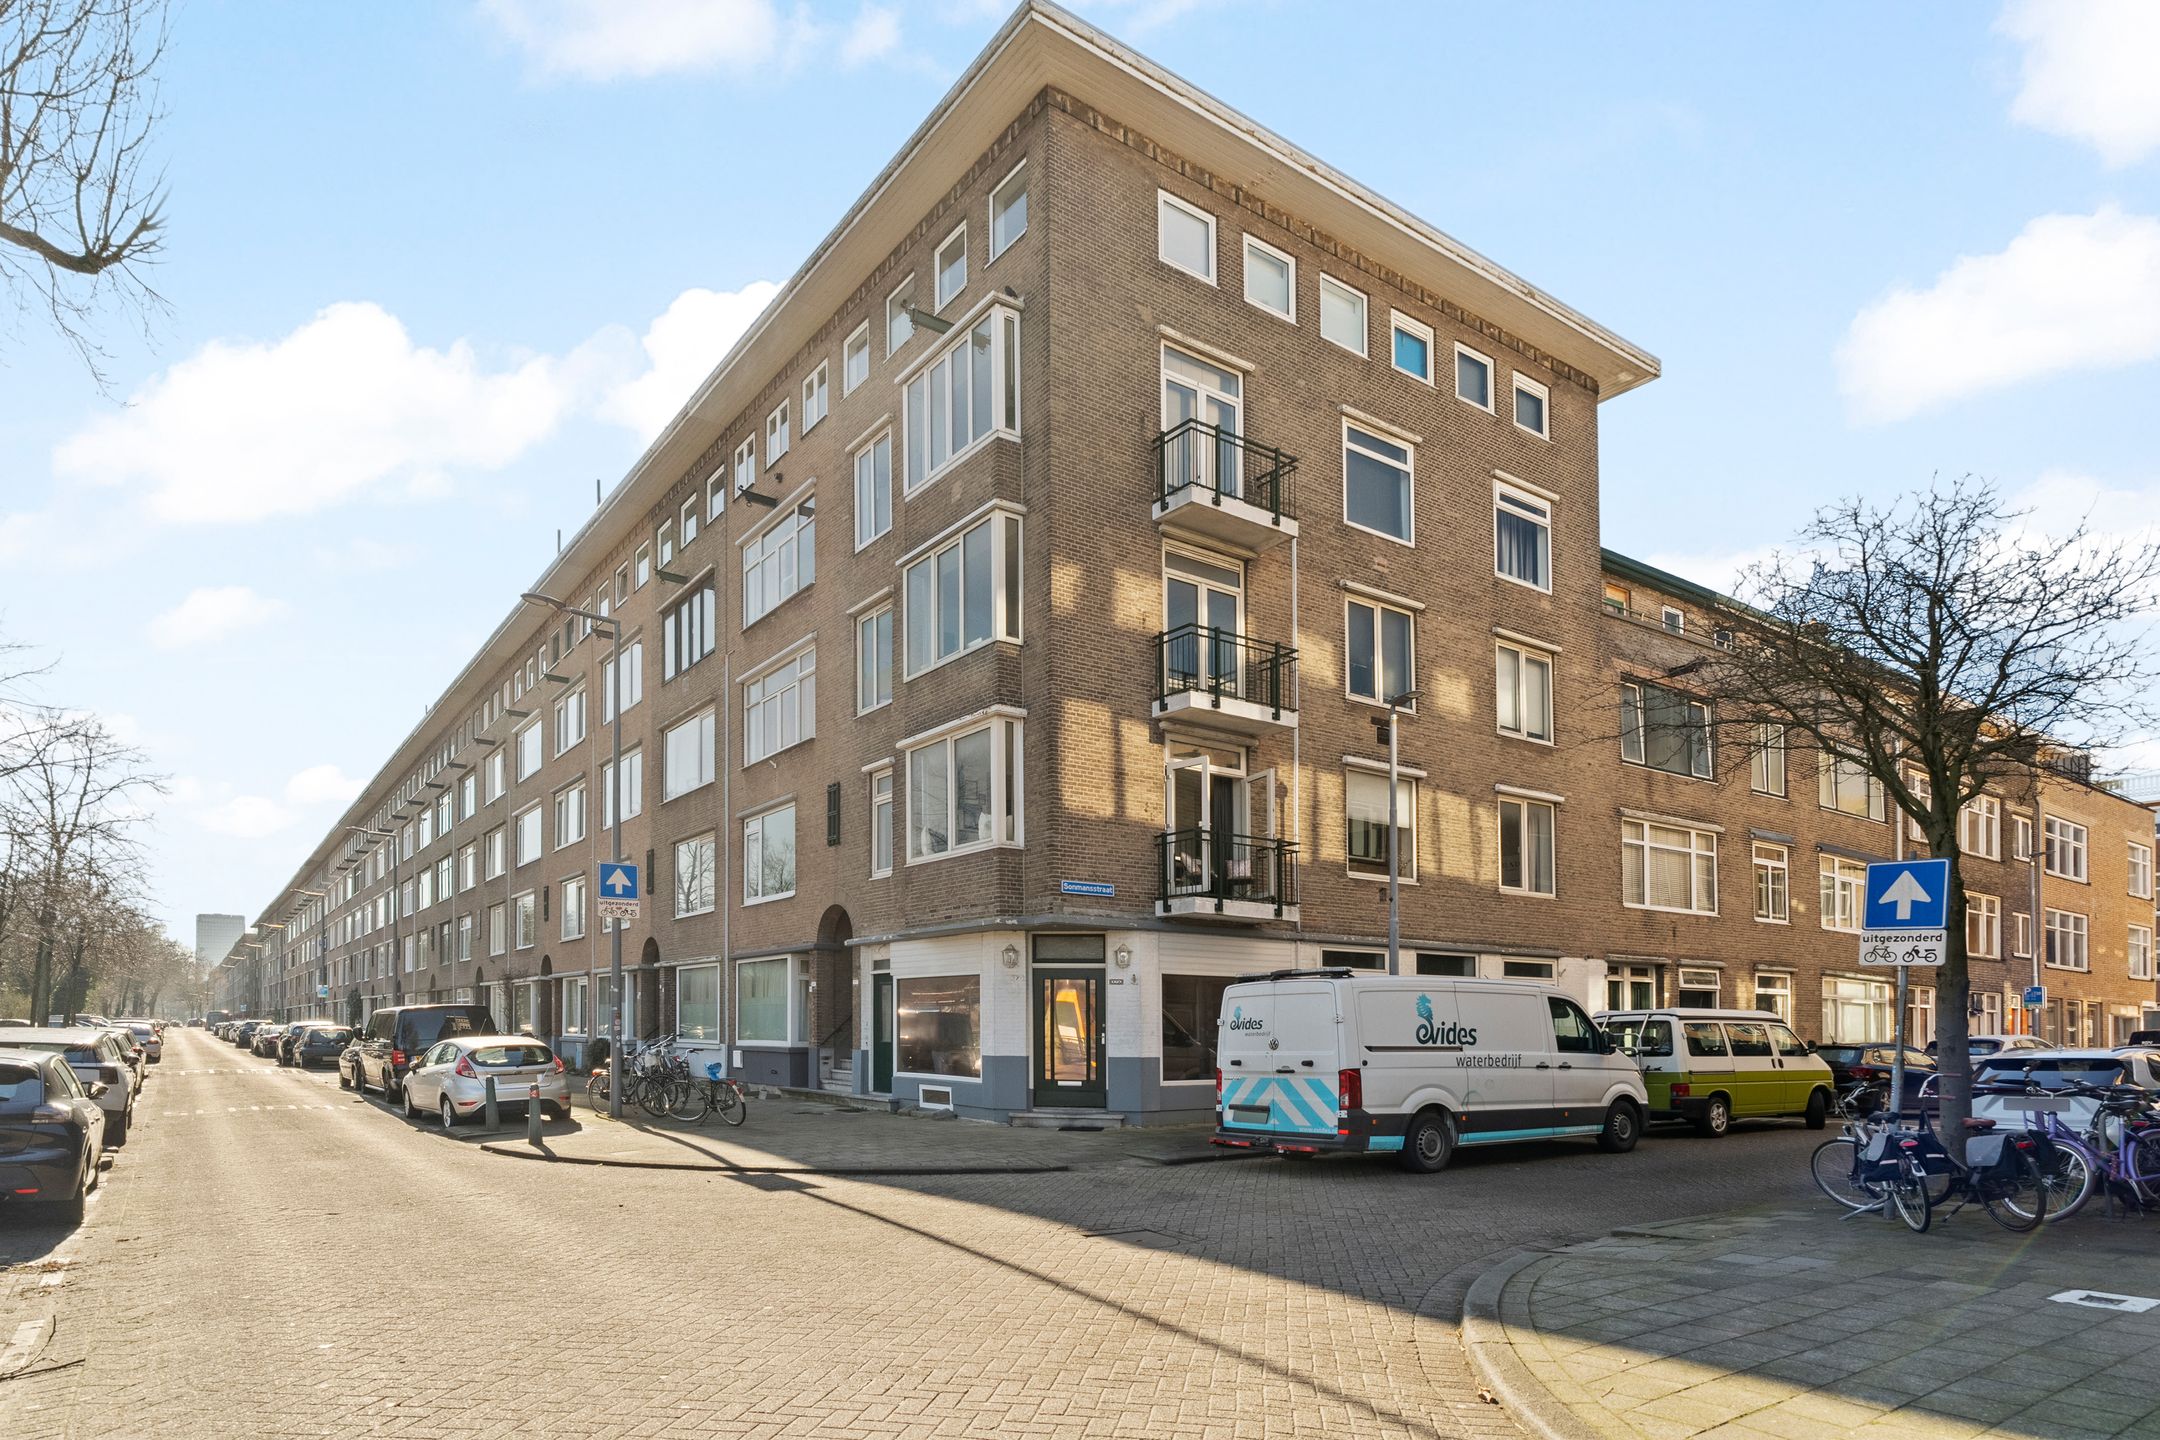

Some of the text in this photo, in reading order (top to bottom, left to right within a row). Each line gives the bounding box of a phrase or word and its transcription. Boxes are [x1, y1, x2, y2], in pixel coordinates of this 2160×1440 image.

[1063, 882, 1113, 893] Sonmansstraat
[1862, 933, 1943, 945] uitgezonderd
[1456, 1054, 1522, 1069] waterbedrijf
